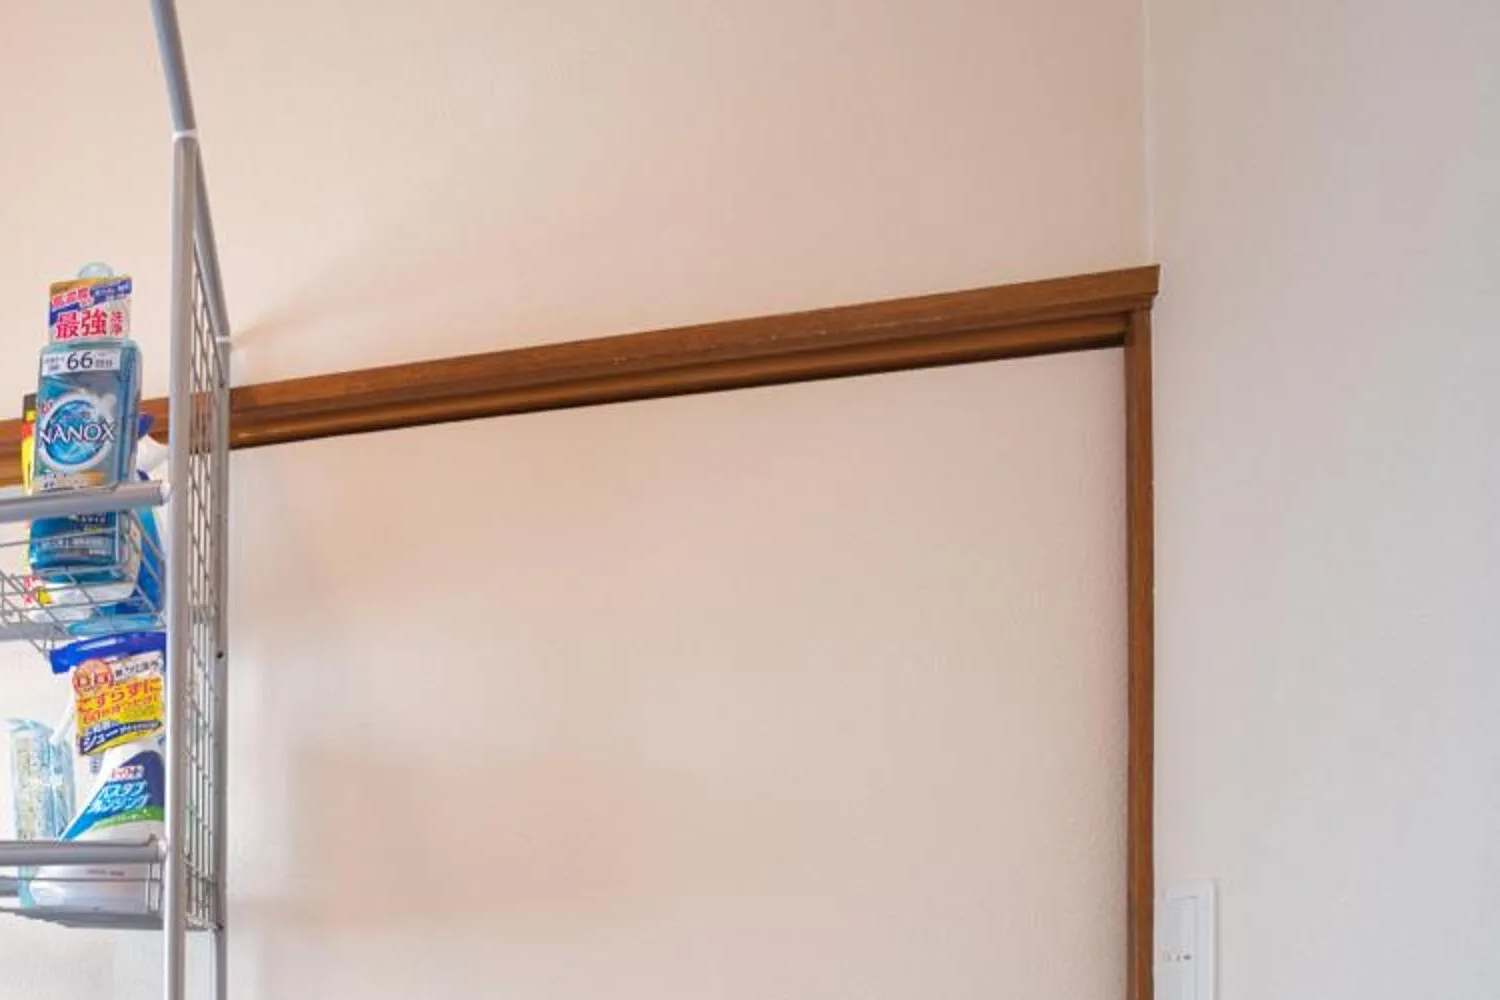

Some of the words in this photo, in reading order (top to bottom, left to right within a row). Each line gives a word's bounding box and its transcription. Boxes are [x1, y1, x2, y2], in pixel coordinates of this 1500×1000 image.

[56, 308, 107, 339] 最強
[67, 351, 93, 370] 66
[40, 419, 115, 444] NANOX
